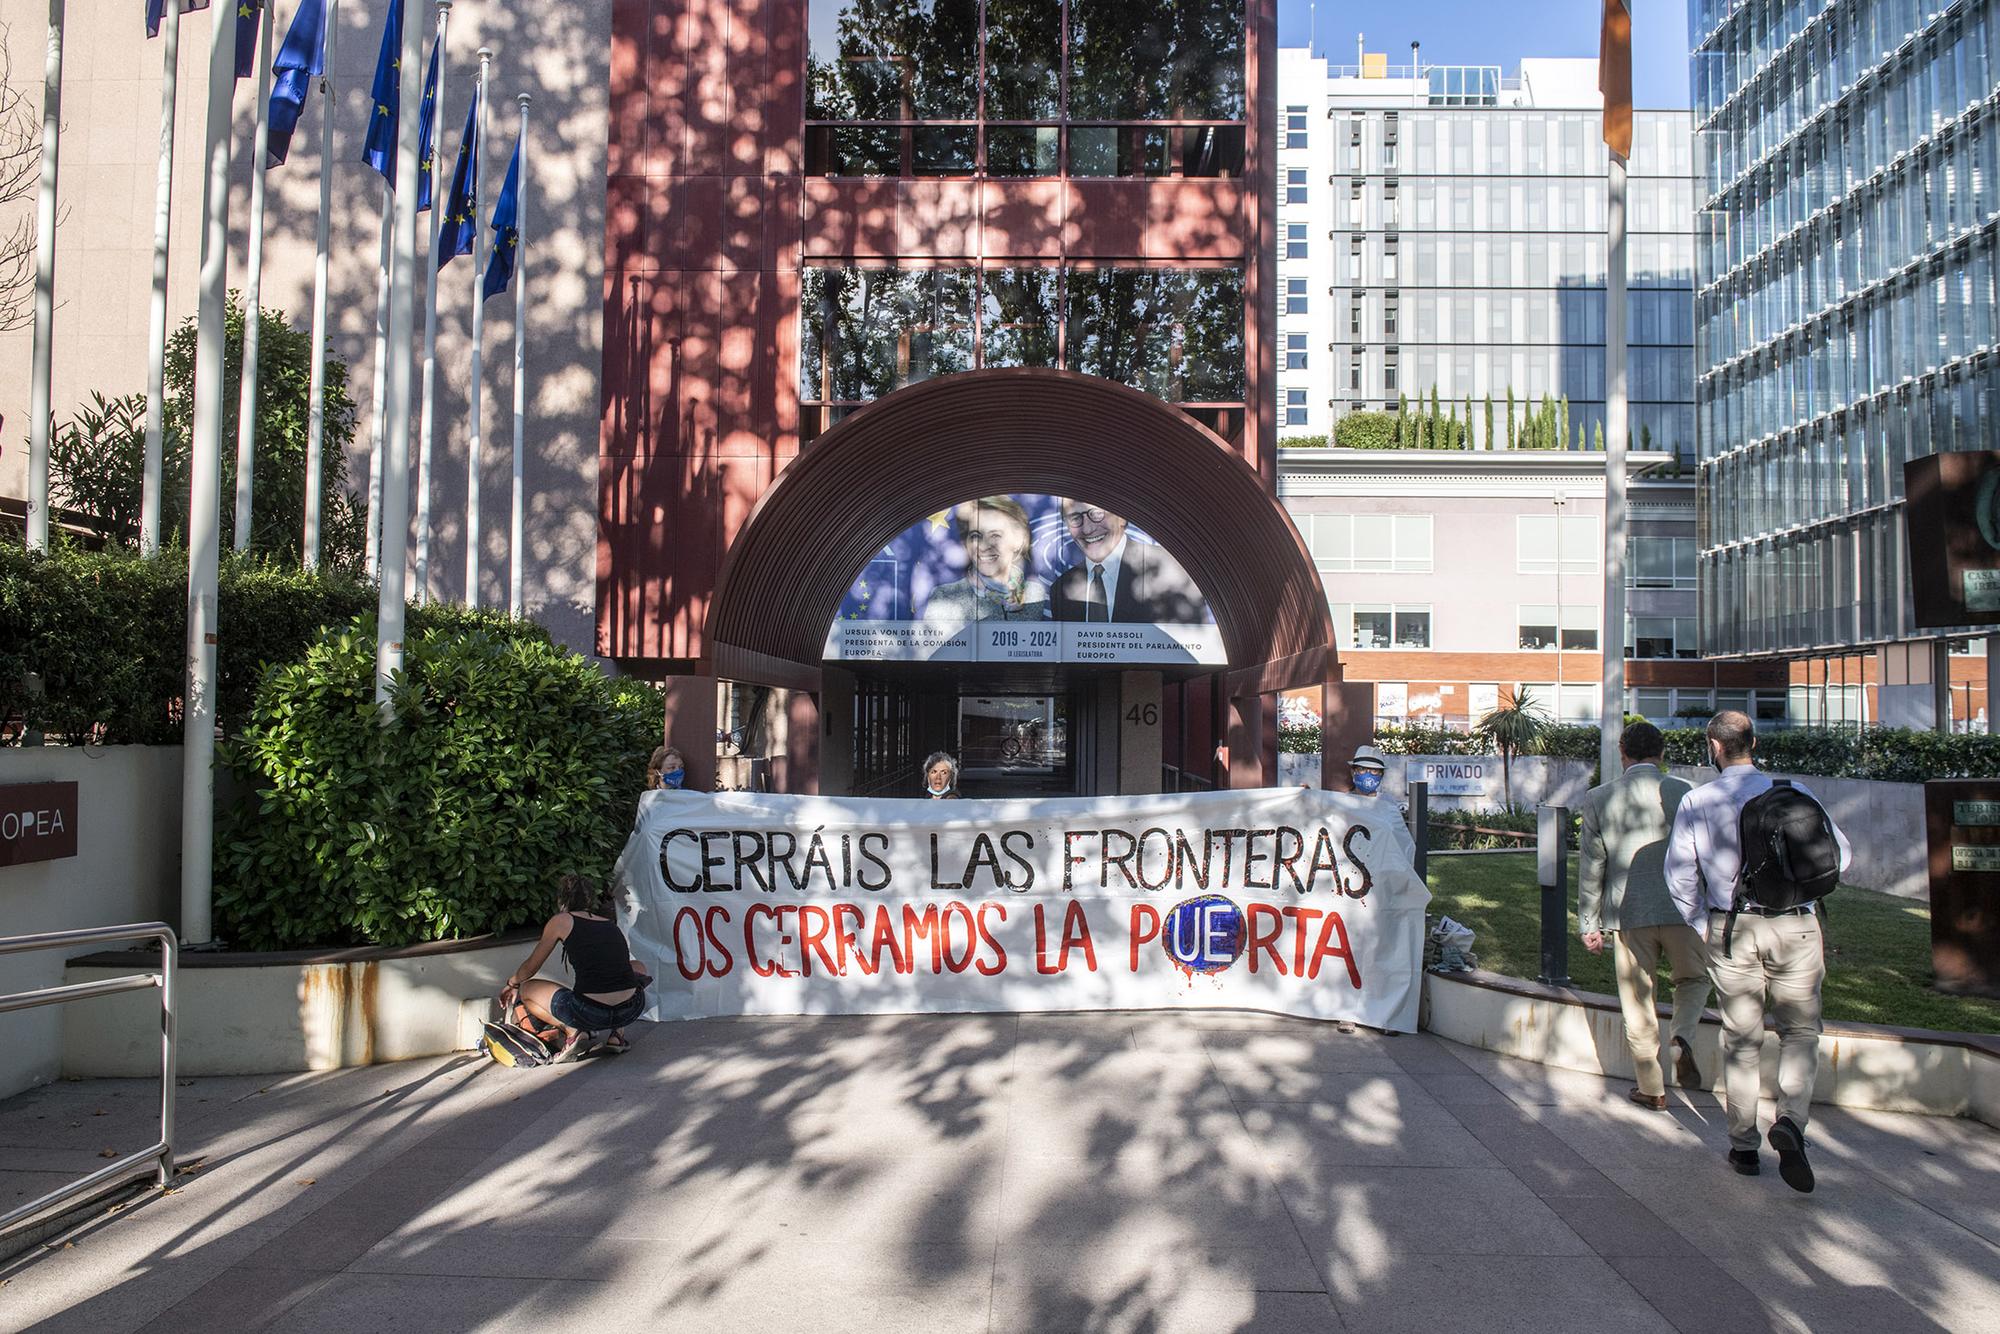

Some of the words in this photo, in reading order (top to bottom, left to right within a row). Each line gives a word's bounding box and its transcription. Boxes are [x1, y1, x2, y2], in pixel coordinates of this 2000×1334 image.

[901, 629, 916, 637] DER
[918, 629, 944, 637] LEYEN
[1106, 631, 1143, 639] SASSOLI
[845, 639, 894, 647] PRESIDENTA
[897, 639, 907, 647] DE
[910, 639, 920, 647] LA
[923, 638, 967, 647] COMISIÓN
[992, 630, 1018, 647] 2019
[1030, 631, 1057, 647] 2024
[1129, 642, 1143, 650] DEL
[1146, 642, 1202, 650] PARLAMENTO
[845, 649, 882, 657] EUROPEA
[1077, 652, 1116, 660] EUROPEO
[1126, 703, 1157, 726] 46
[1426, 764, 1482, 779] PRIVADO
[659, 825, 893, 893] CERRÁIS
[930, 830, 1035, 893] LAS
[1062, 824, 1374, 900] FRONTERAS
[673, 905, 734, 981] OS
[744, 902, 1008, 978] CERRAMOS
[1033, 900, 1098, 975] LA
[1129, 901, 1362, 990] PUERTA
